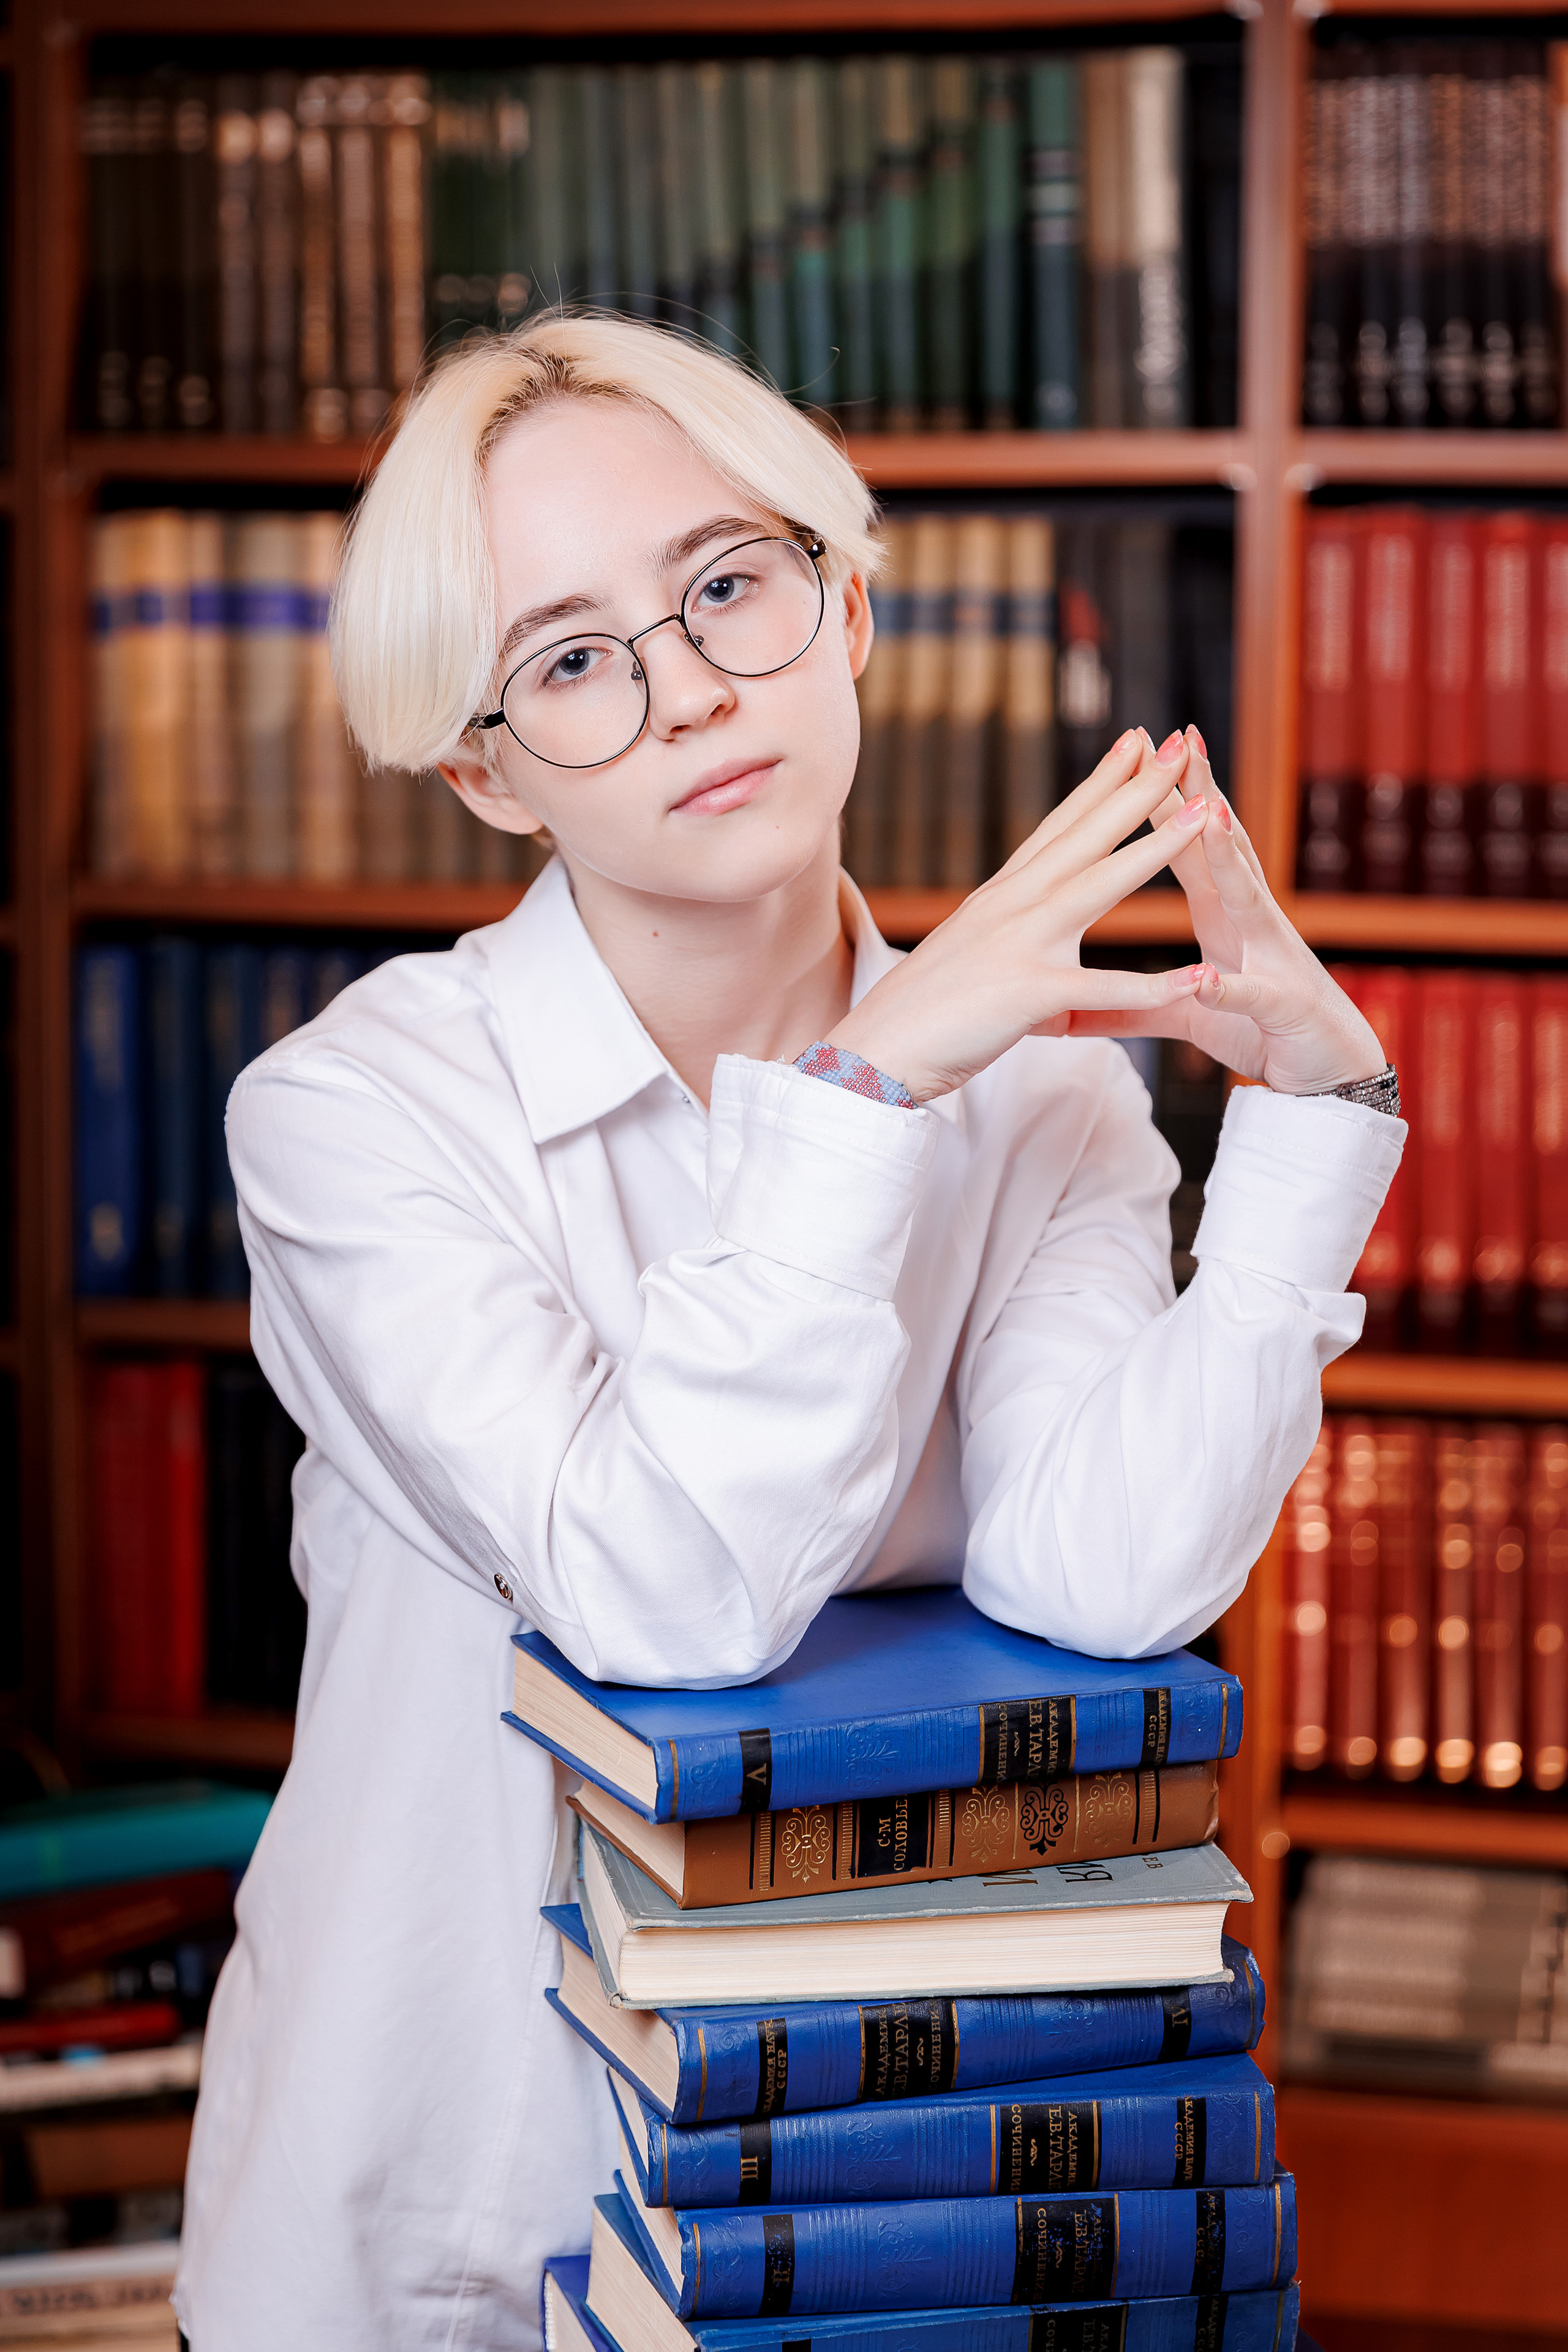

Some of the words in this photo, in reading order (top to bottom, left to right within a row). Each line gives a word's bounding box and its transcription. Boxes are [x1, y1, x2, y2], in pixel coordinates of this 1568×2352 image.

[997, 1703, 1008, 1781] СОЧИНЕНИ
[1147, 1715, 1157, 1747] СССР
[747, 1763, 767, 1785] V
[894, 1794, 908, 1871] СОЛОВЬЕ
[1142, 1854, 1164, 1869] ЕВ
[777, 2049, 786, 2089] СССР
[1011, 2104, 1022, 2192] СОЧИНЕНИЯ
[1067, 2111, 1078, 2187] АКАДЕМИК
[1174, 2122, 1183, 2159] СССР
[740, 2156, 758, 2181] III
[1183, 2157, 1193, 2182] НАУК
[1196, 2227, 1205, 2265] СССР
[773, 2267, 790, 2284] II
